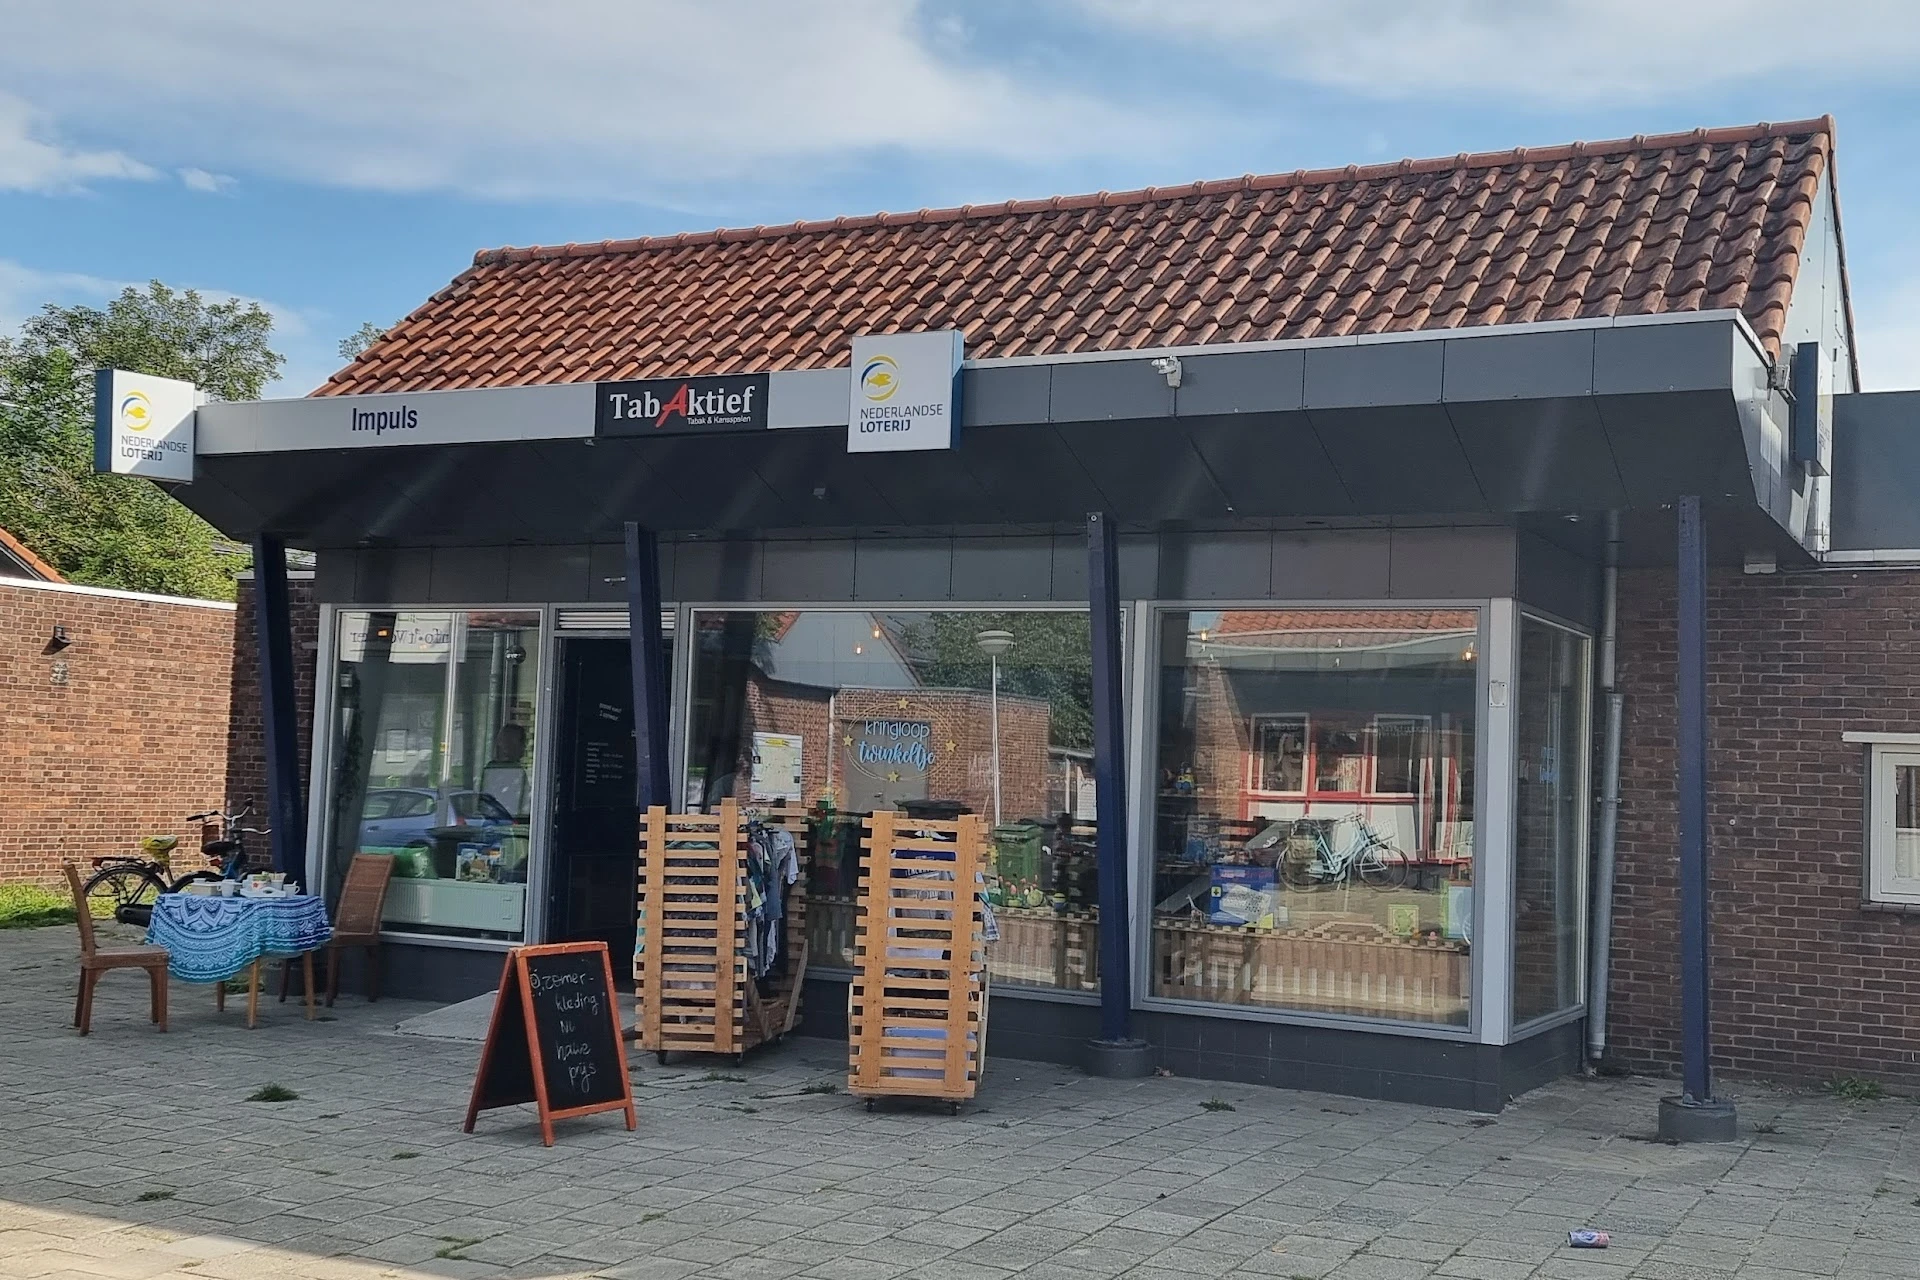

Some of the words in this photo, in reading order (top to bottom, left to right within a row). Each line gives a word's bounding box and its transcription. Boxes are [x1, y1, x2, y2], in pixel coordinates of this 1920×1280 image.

[610, 384, 756, 428] TabAktief
[860, 404, 943, 420] NEDERLANDSE
[352, 405, 418, 435] Impuls
[687, 417, 706, 425] Tabak
[707, 416, 712, 424] &
[713, 415, 751, 425] Kansspelen
[860, 418, 911, 434] LOTERIJ
[121, 435, 188, 454] NEDERLANDSE
[121, 445, 163, 462] LOTERIJ
[865, 720, 930, 740] kringloop
[859, 740, 935, 771] twinkeltje
[555, 992, 599, 1015] kleding
